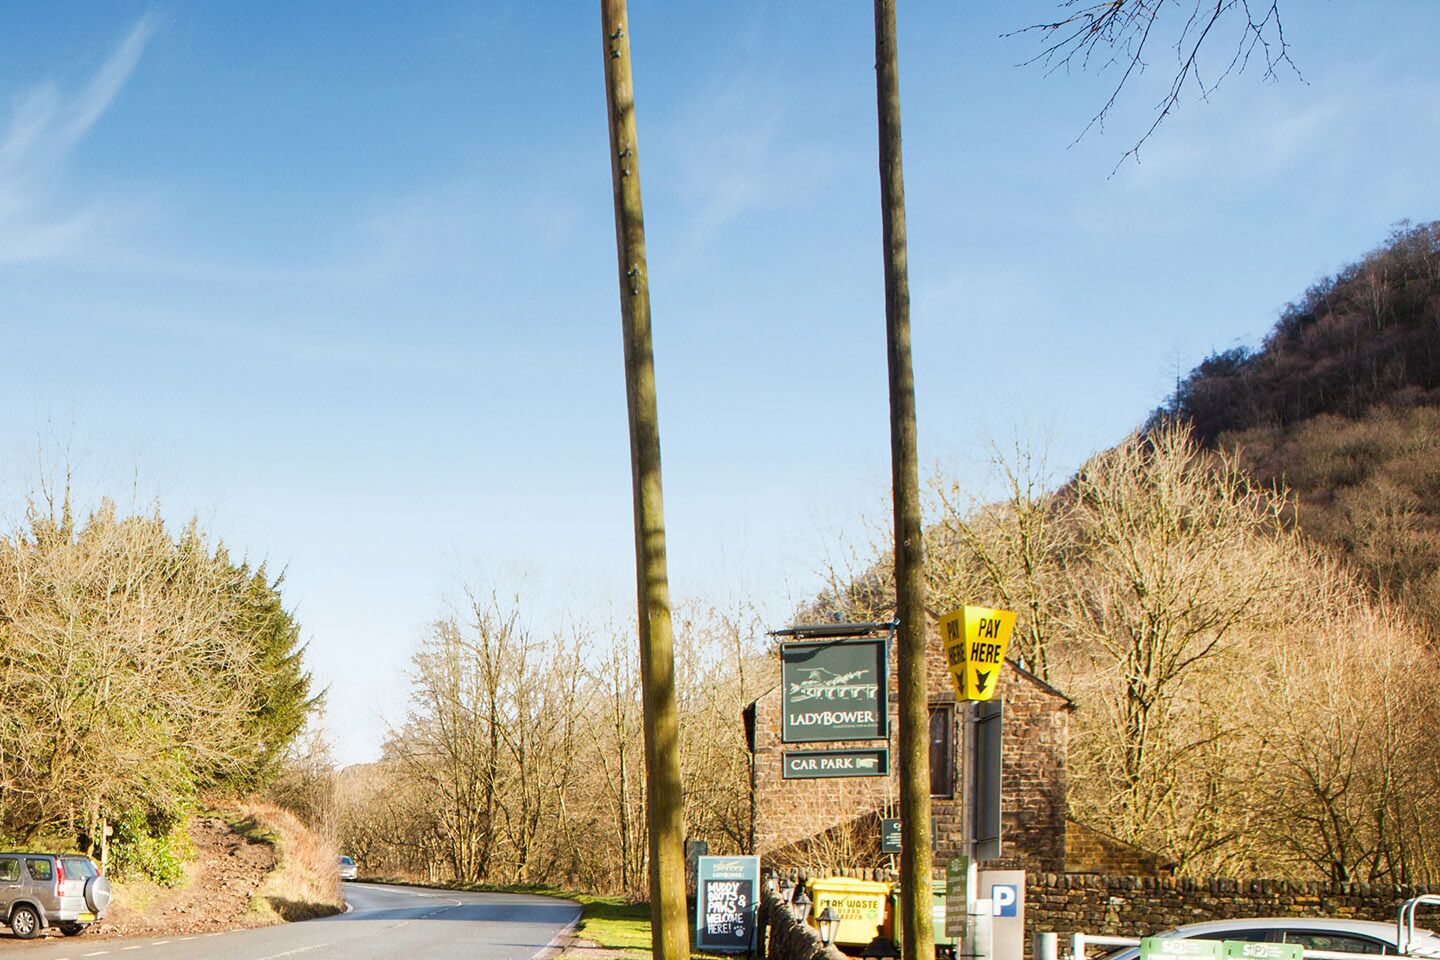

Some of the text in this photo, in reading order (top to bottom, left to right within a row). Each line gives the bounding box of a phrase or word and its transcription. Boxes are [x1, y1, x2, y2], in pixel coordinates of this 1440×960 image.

[978, 618, 1002, 639] PAY
[970, 642, 1002, 664] HERE
[789, 710, 875, 726] LADYBOWER
[790, 757, 854, 770] CAR PARK
[707, 881, 740, 894] MUDDY
[707, 892, 747, 908] BOOTS &
[846, 899, 879, 909] WASTE
[993, 887, 1015, 916] P
[707, 901, 737, 914] PAWS
[706, 912, 745, 924] WELCOME
[707, 923, 732, 935] HERE!
